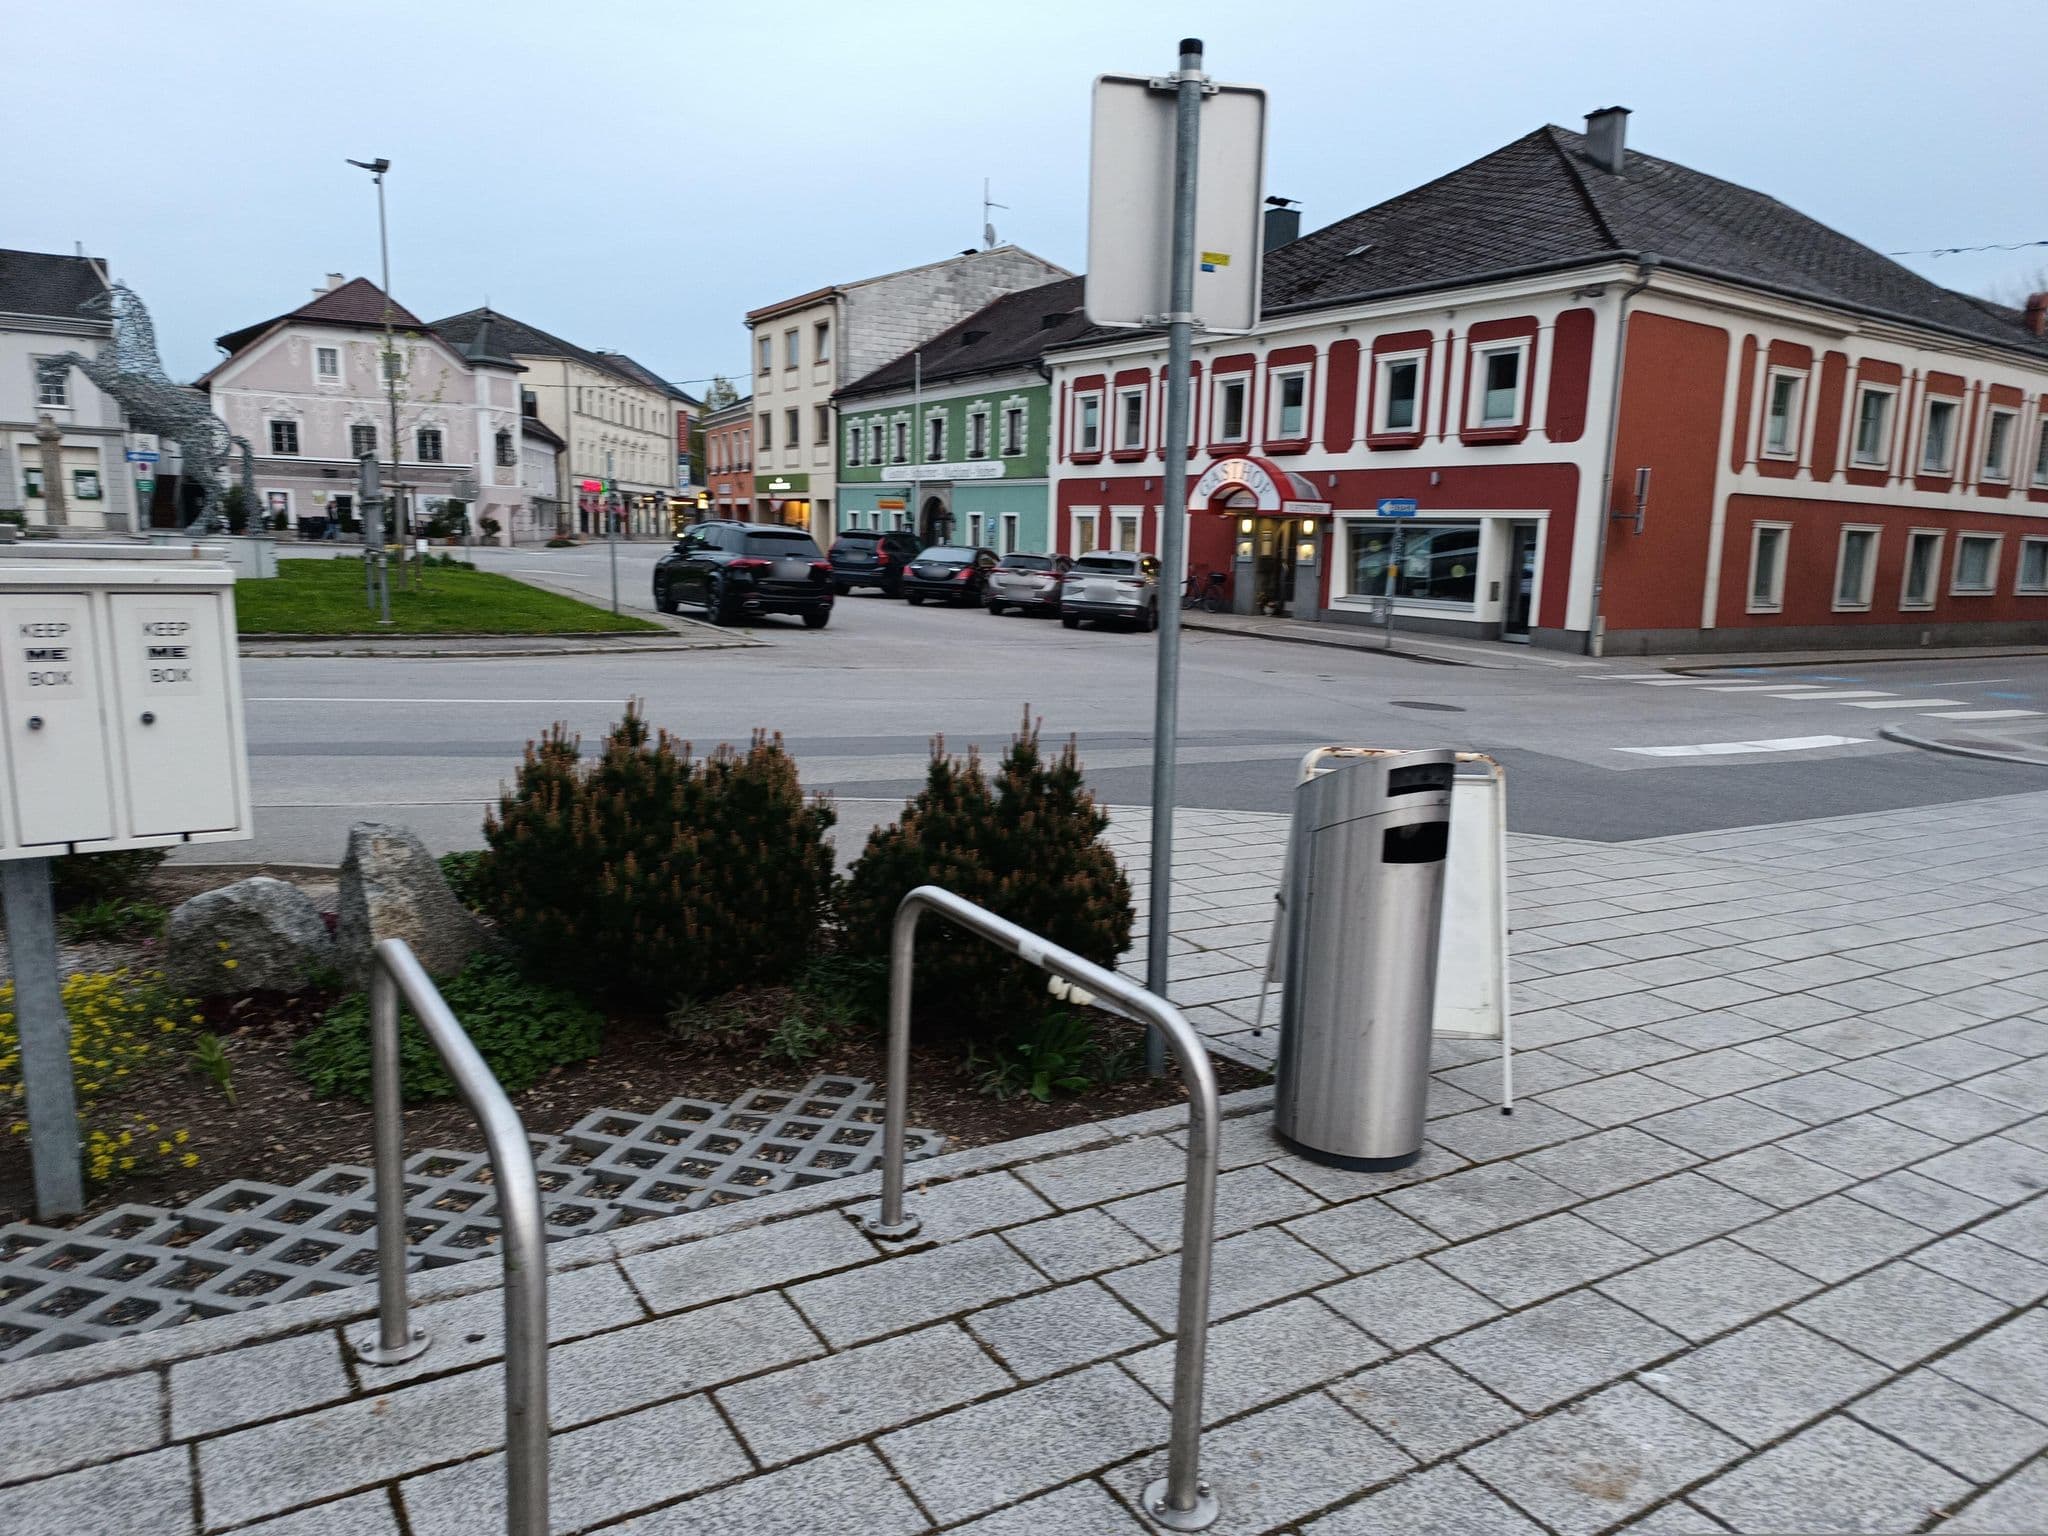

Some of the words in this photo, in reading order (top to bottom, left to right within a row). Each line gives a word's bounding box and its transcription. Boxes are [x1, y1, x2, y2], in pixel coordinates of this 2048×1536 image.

[1199, 461, 1271, 496] GASTHOF
[19, 623, 71, 638] KEEP
[142, 622, 191, 637] KEEP
[25, 649, 68, 661] ME
[147, 647, 187, 658] ME
[28, 671, 72, 687] BOX
[149, 668, 192, 683] BOX
